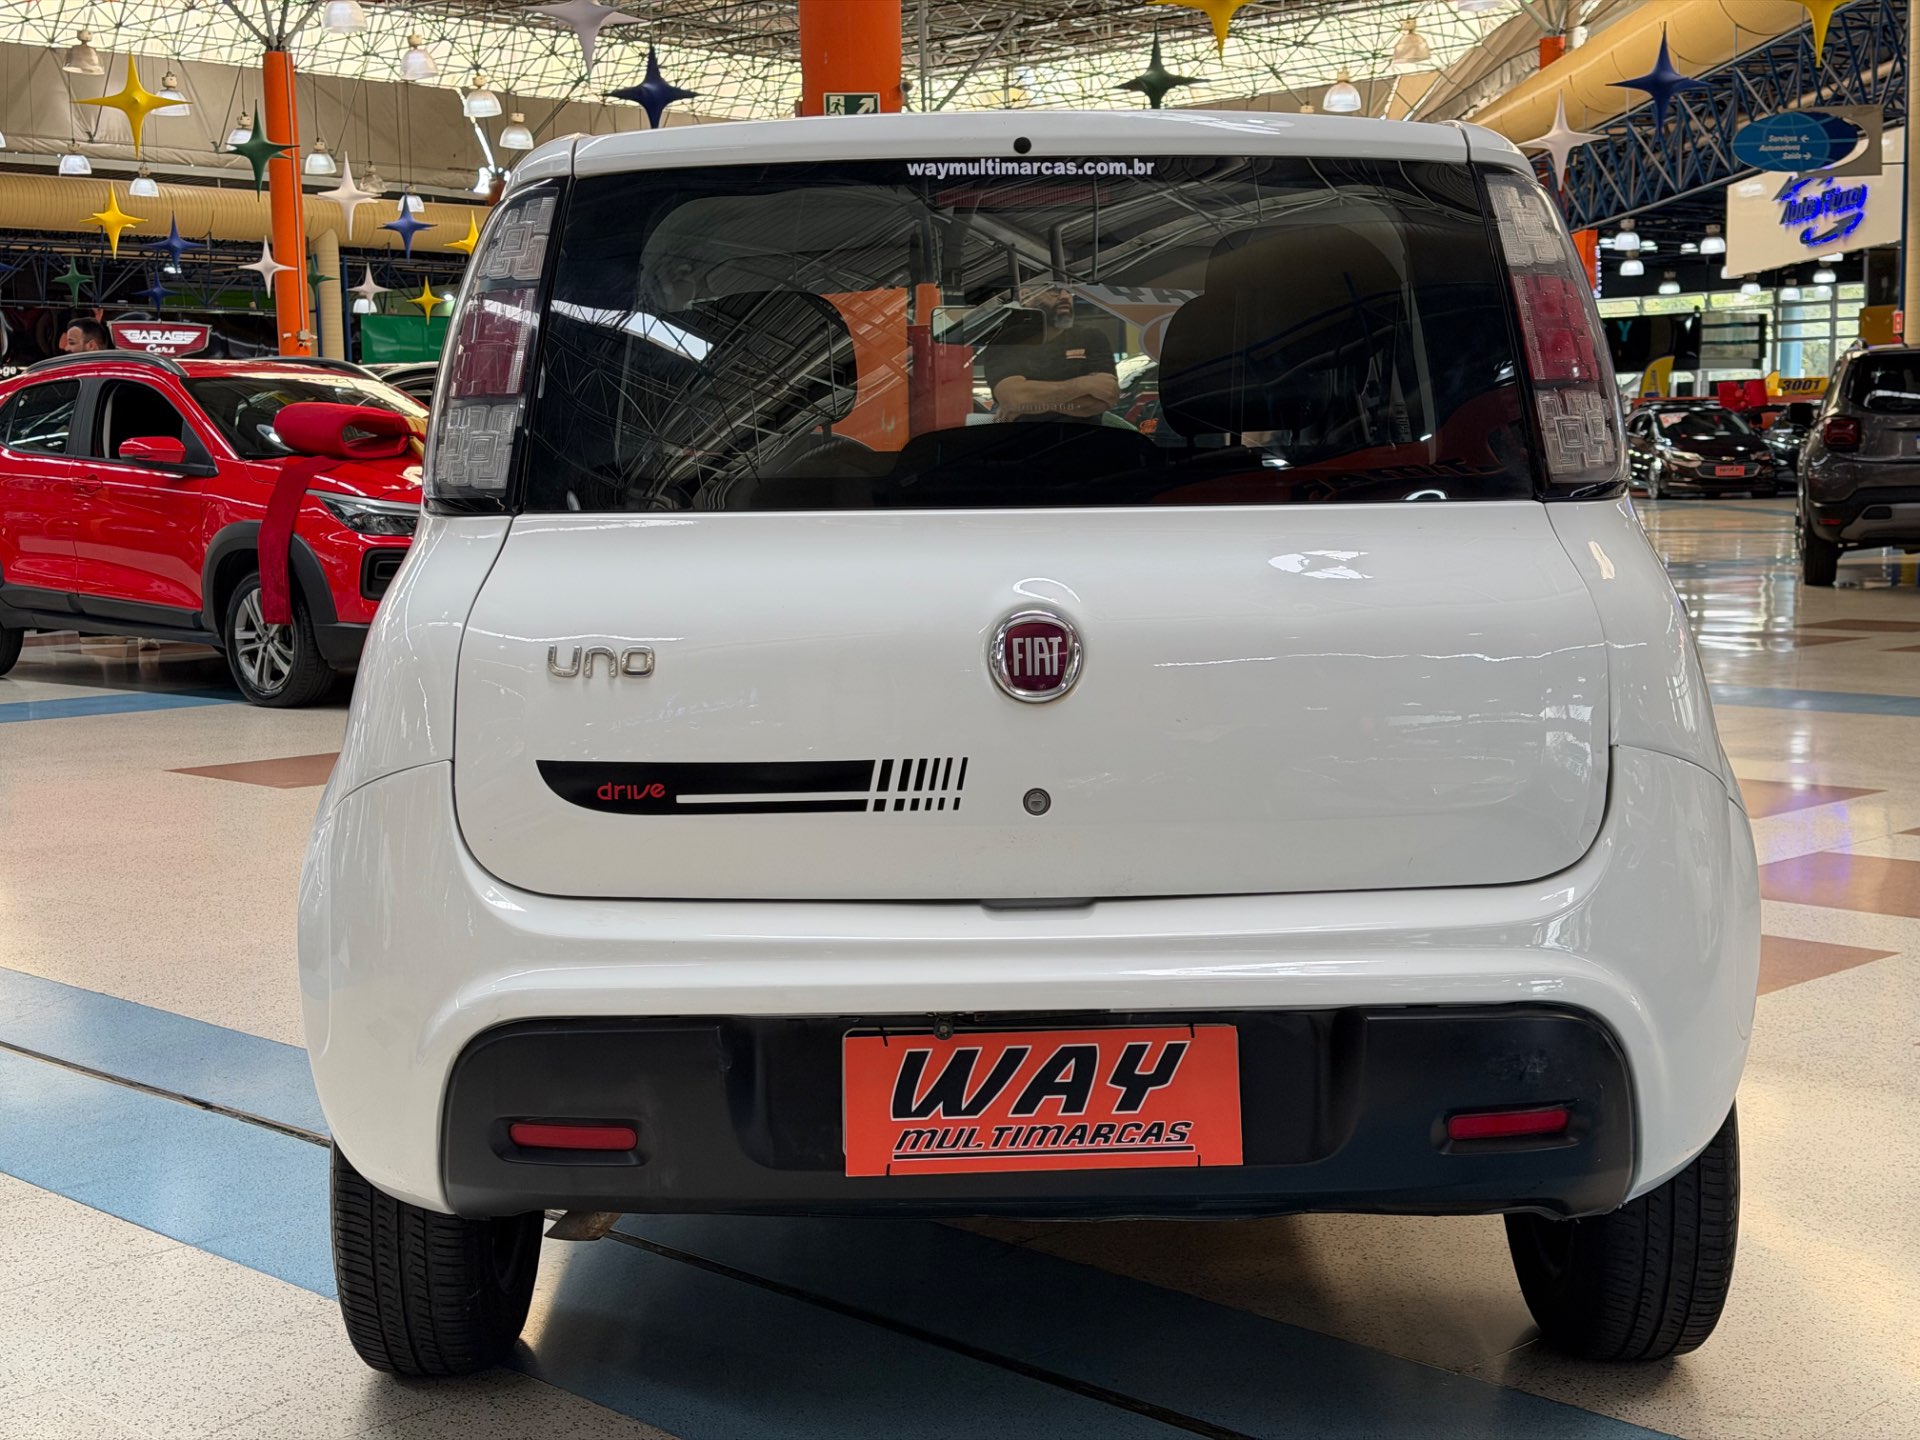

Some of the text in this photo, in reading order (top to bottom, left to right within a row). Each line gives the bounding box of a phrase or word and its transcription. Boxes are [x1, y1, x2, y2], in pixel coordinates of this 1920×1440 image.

[907, 158, 1155, 180] waymultimarcas.com.br
[1780, 198, 1821, 225] Auto
[119, 330, 201, 342] GARAGE
[146, 344, 176, 356] Cars
[1783, 380, 1821, 391] 3001
[1012, 636, 1063, 677] FIAT
[597, 782, 666, 801] drive
[890, 1040, 1191, 1121] WAY
[893, 1121, 1194, 1152] MULTIMARCAS
